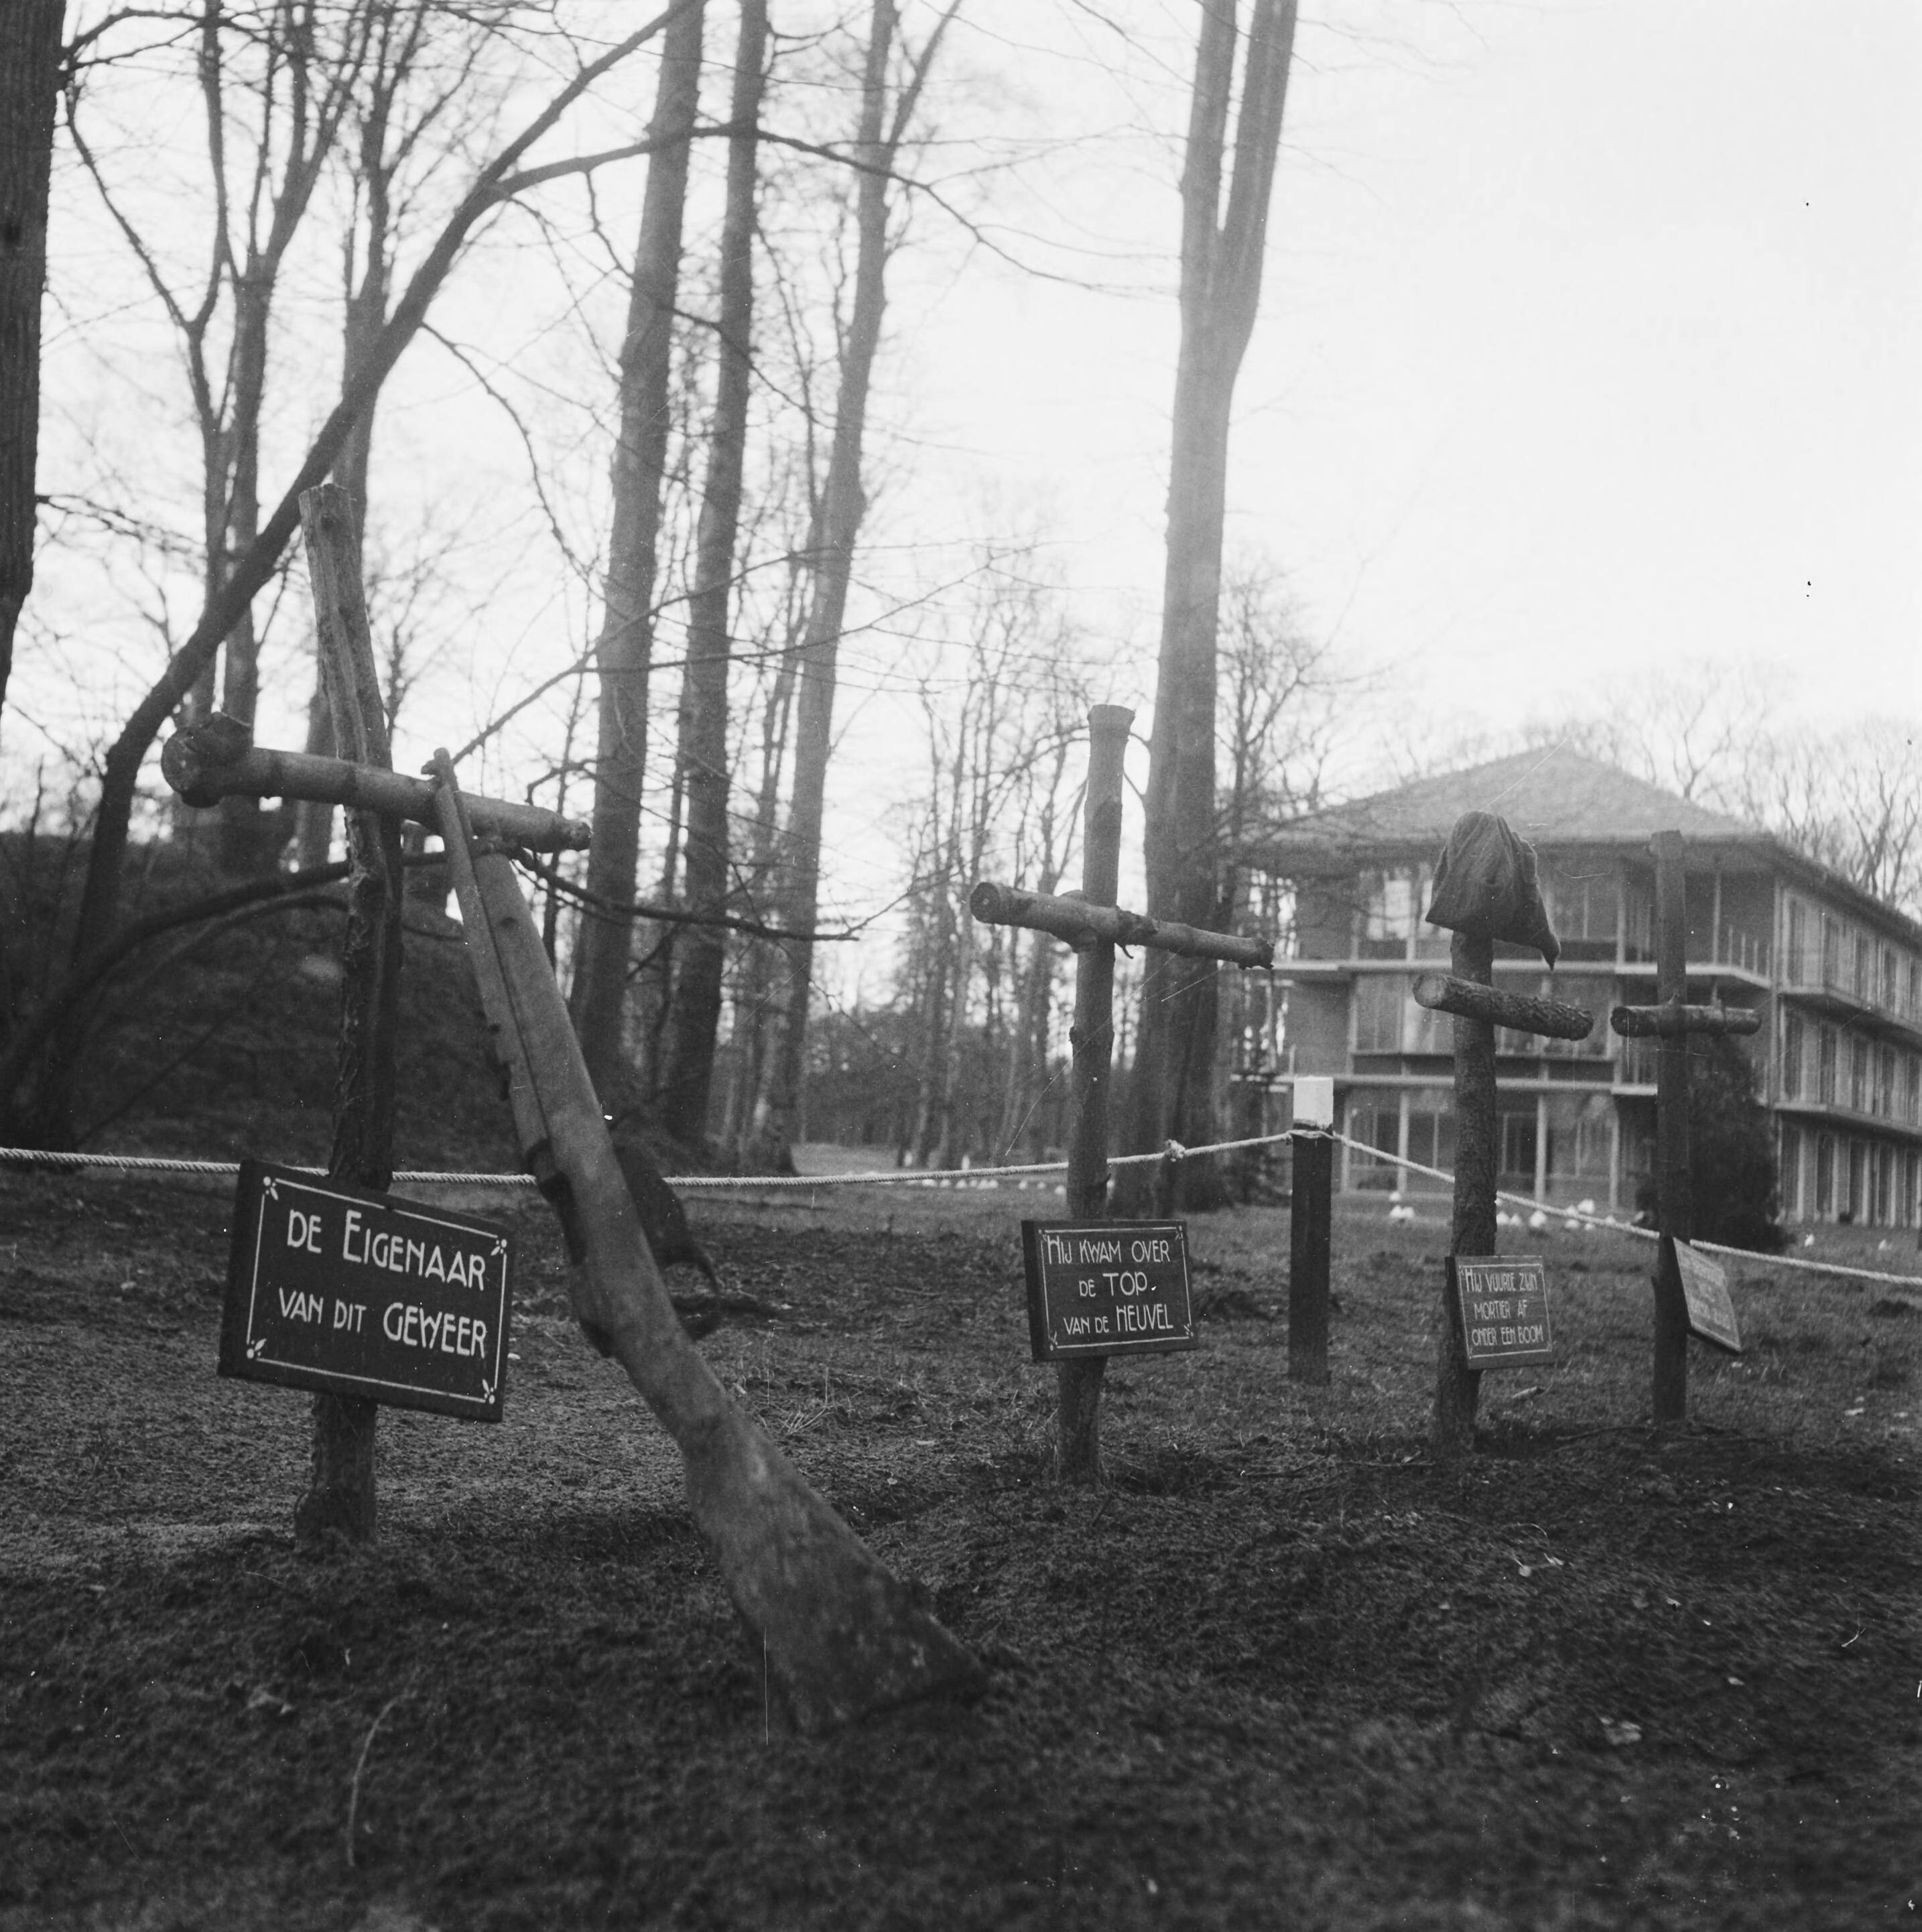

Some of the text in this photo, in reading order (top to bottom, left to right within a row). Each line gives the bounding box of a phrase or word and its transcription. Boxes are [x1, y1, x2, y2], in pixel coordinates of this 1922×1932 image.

[287, 1209, 487, 1291] DE EIGENAAR
[1047, 1235, 1170, 1264] HIJ KWAM OVER
[1078, 1279, 1096, 1297] DE
[279, 1287, 488, 1359] VAN DIT GEWEER
[1063, 1303, 1173, 1335] VAN DE HEUVEL
[1474, 1299, 1527, 1319] MORTIER AF
[1472, 1325, 1543, 1346] ONDER EEN BOOM
